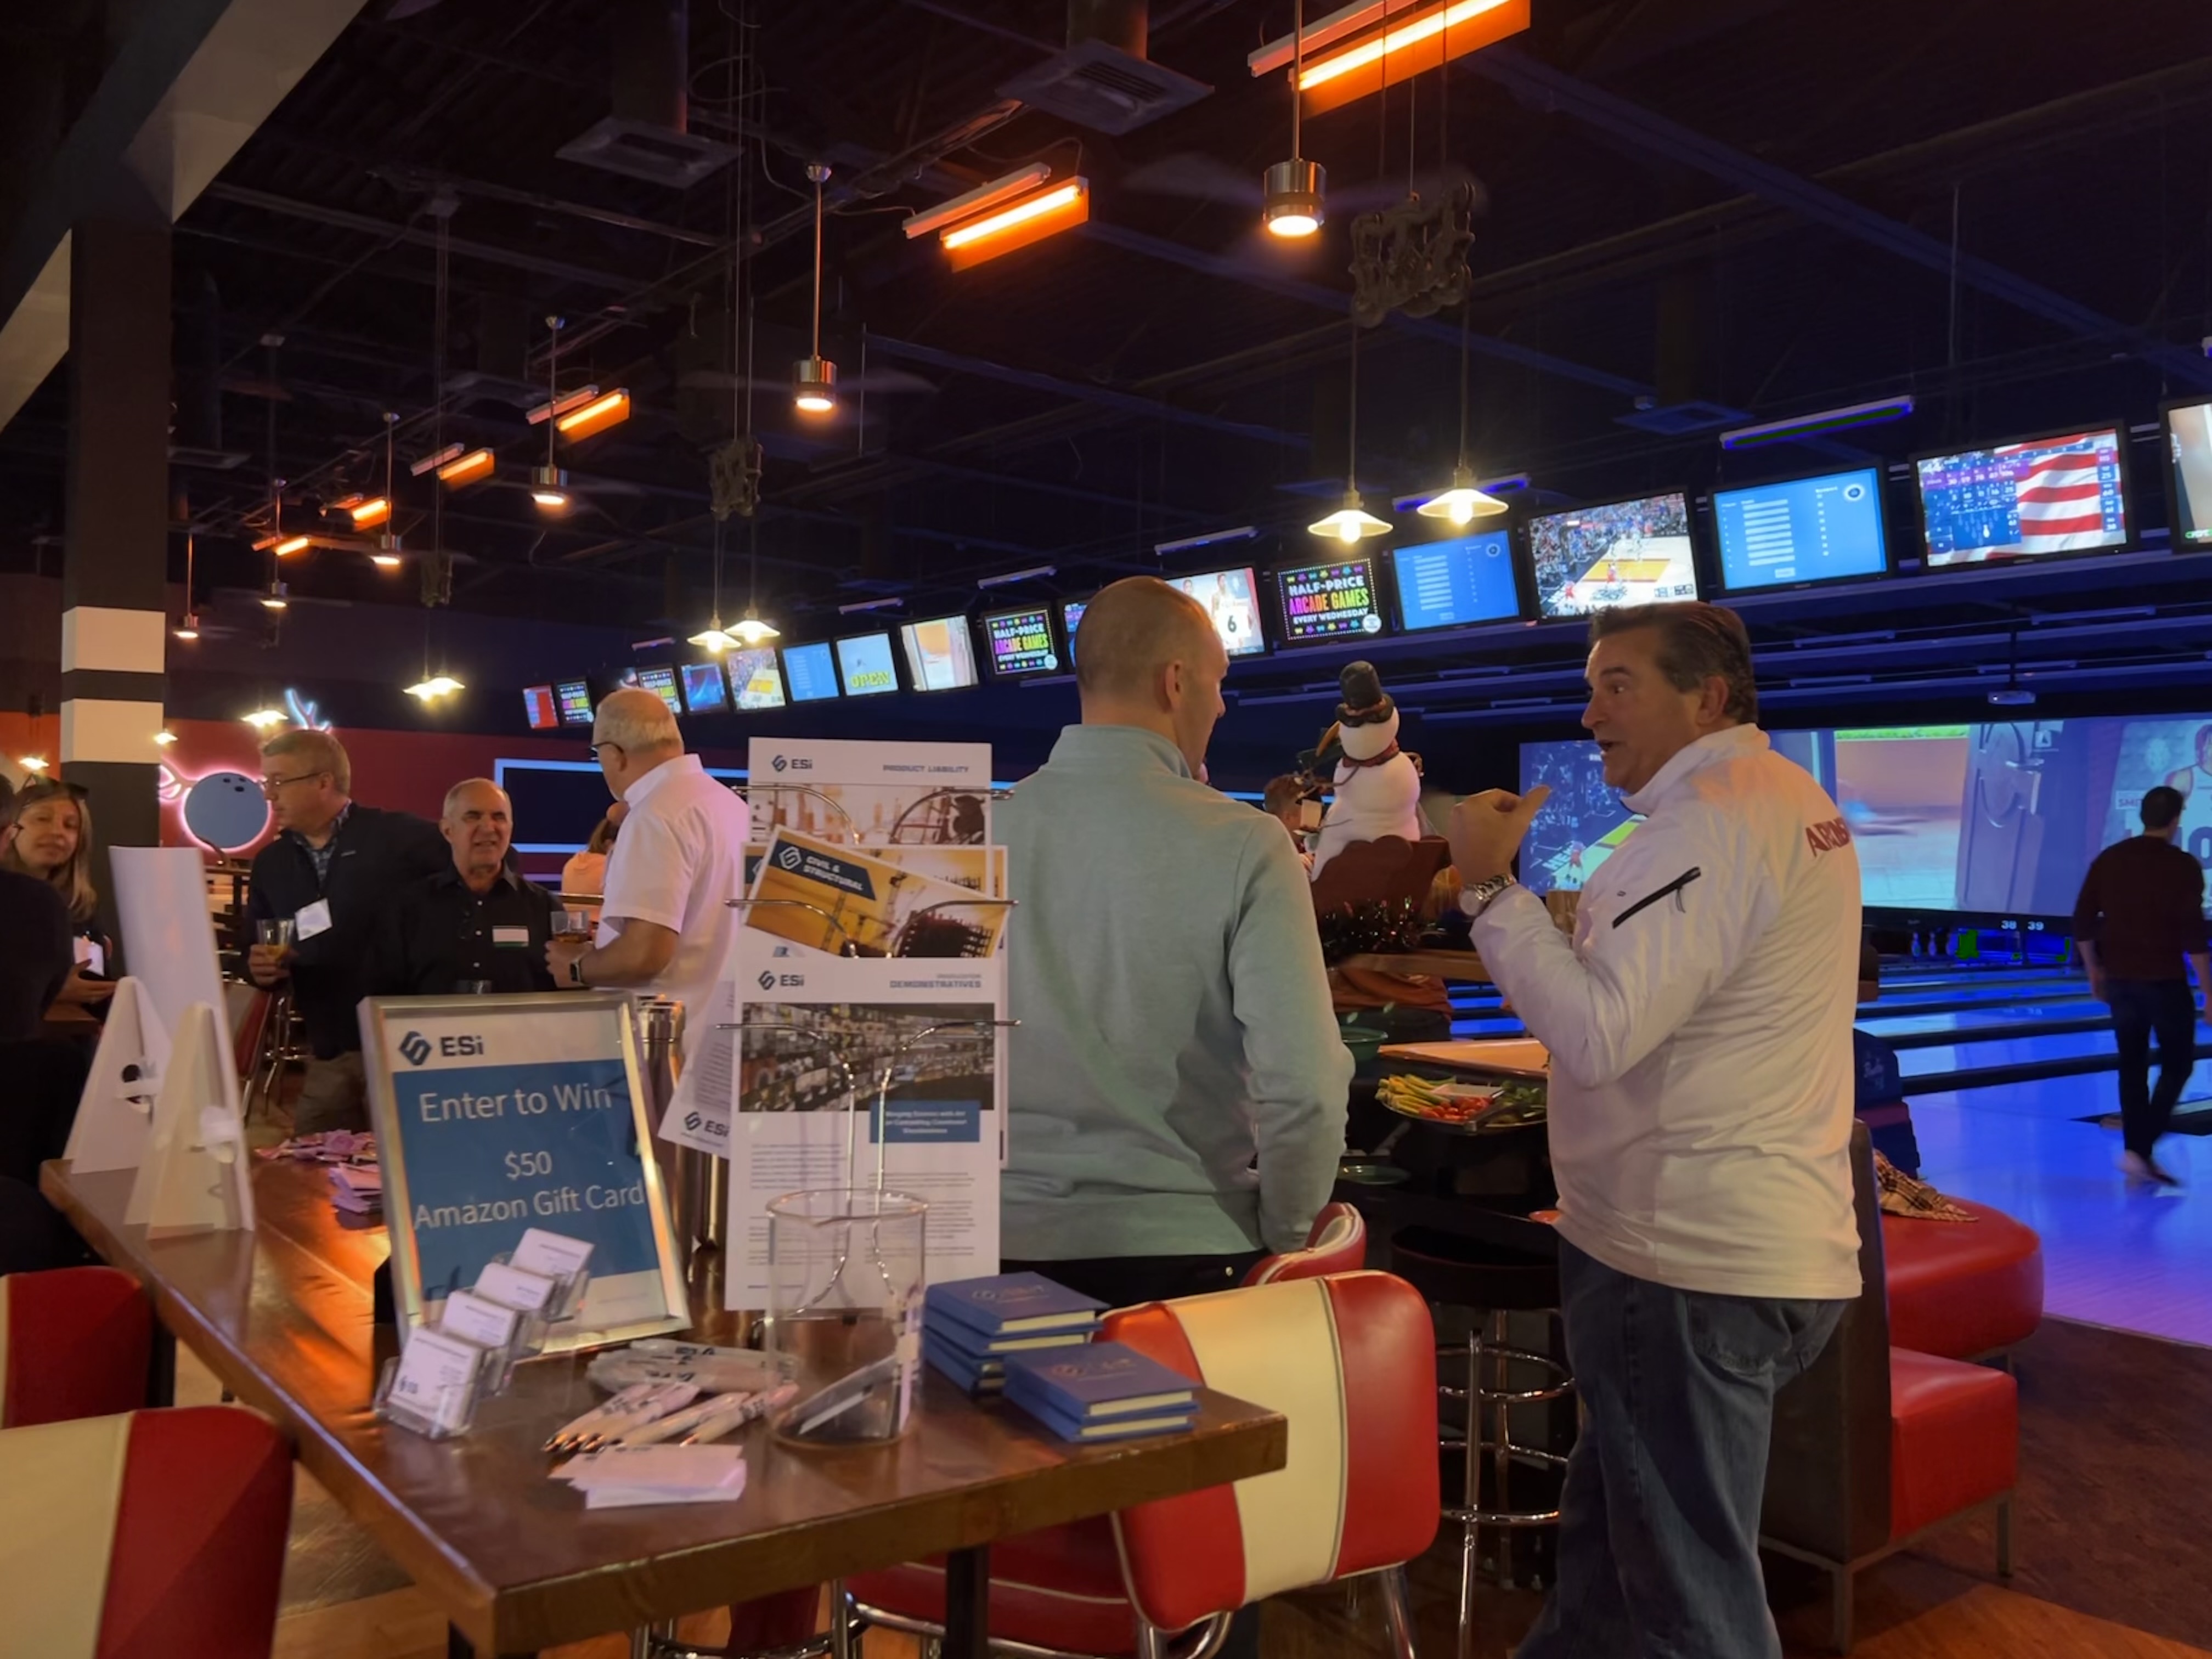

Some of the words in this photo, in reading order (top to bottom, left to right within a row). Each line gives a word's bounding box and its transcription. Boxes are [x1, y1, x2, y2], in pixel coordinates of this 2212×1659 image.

[1289, 575, 1365, 596] HALF-PRICE
[1290, 593, 1330, 615] ARCADE
[1330, 588, 1369, 609] GAMES
[1228, 615, 1237, 633] 6
[1293, 614, 1317, 624] EVERY
[1318, 607, 1369, 621] WEDNESDAY
[791, 759, 812, 770] ESi
[2001, 920, 2017, 929] 38
[2027, 921, 2044, 930] 39
[780, 975, 804, 986] ESi
[441, 1035, 484, 1057] ESi
[420, 1093, 506, 1122] Enter
[516, 1088, 547, 1114] to
[553, 1083, 612, 1111] Win
[704, 1120, 730, 1137] ESi
[505, 1151, 552, 1181] $50
[414, 1196, 527, 1230] Amazon
[534, 1189, 580, 1216] Gift
[586, 1181, 645, 1208] Card
